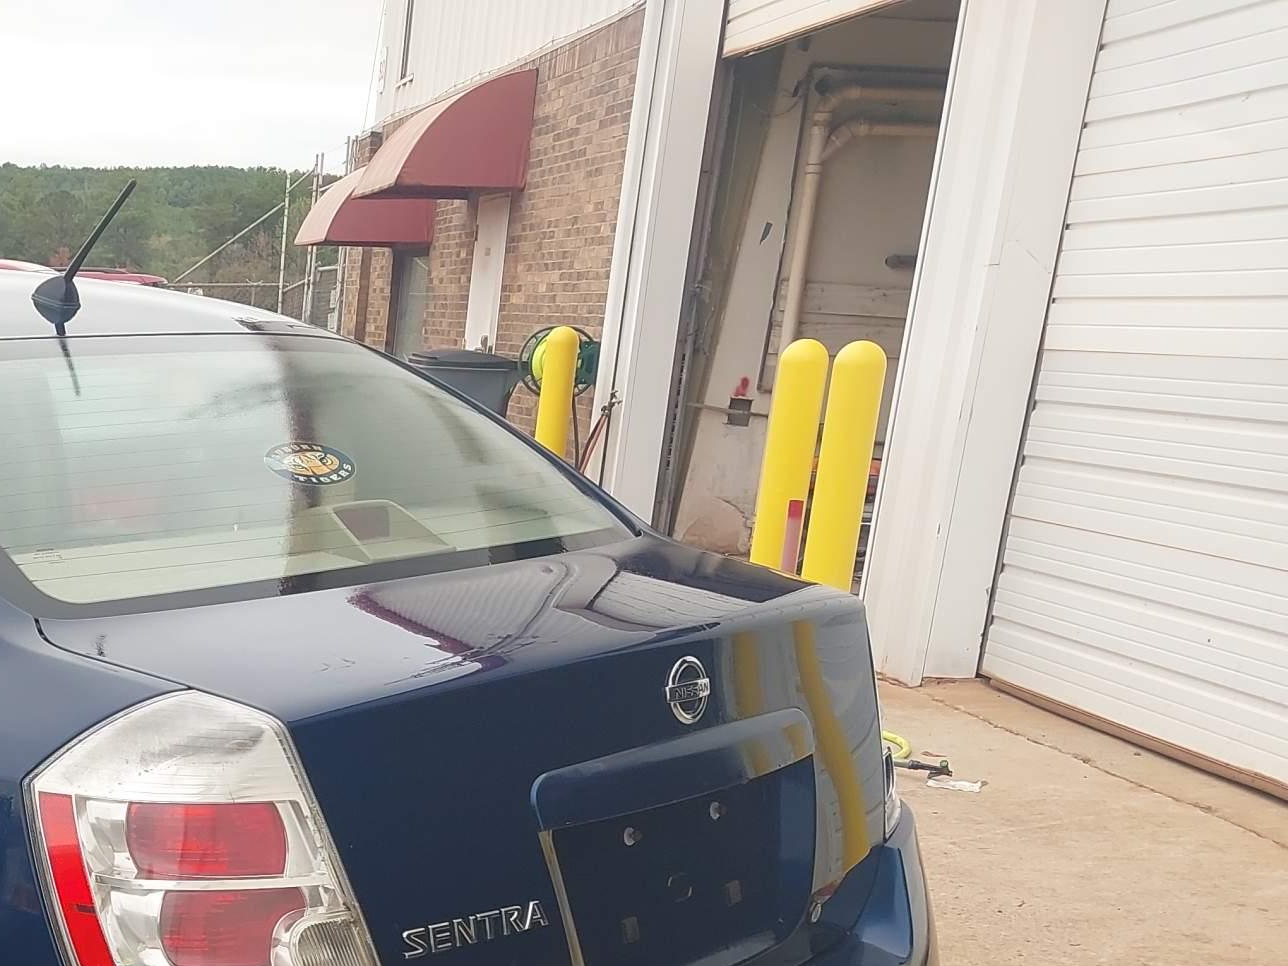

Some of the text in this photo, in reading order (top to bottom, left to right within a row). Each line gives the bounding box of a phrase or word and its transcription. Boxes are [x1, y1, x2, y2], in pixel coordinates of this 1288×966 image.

[294, 463, 352, 483] TIGERS
[675, 681, 709, 700] NISSAN
[402, 900, 549, 959] SENTRA
